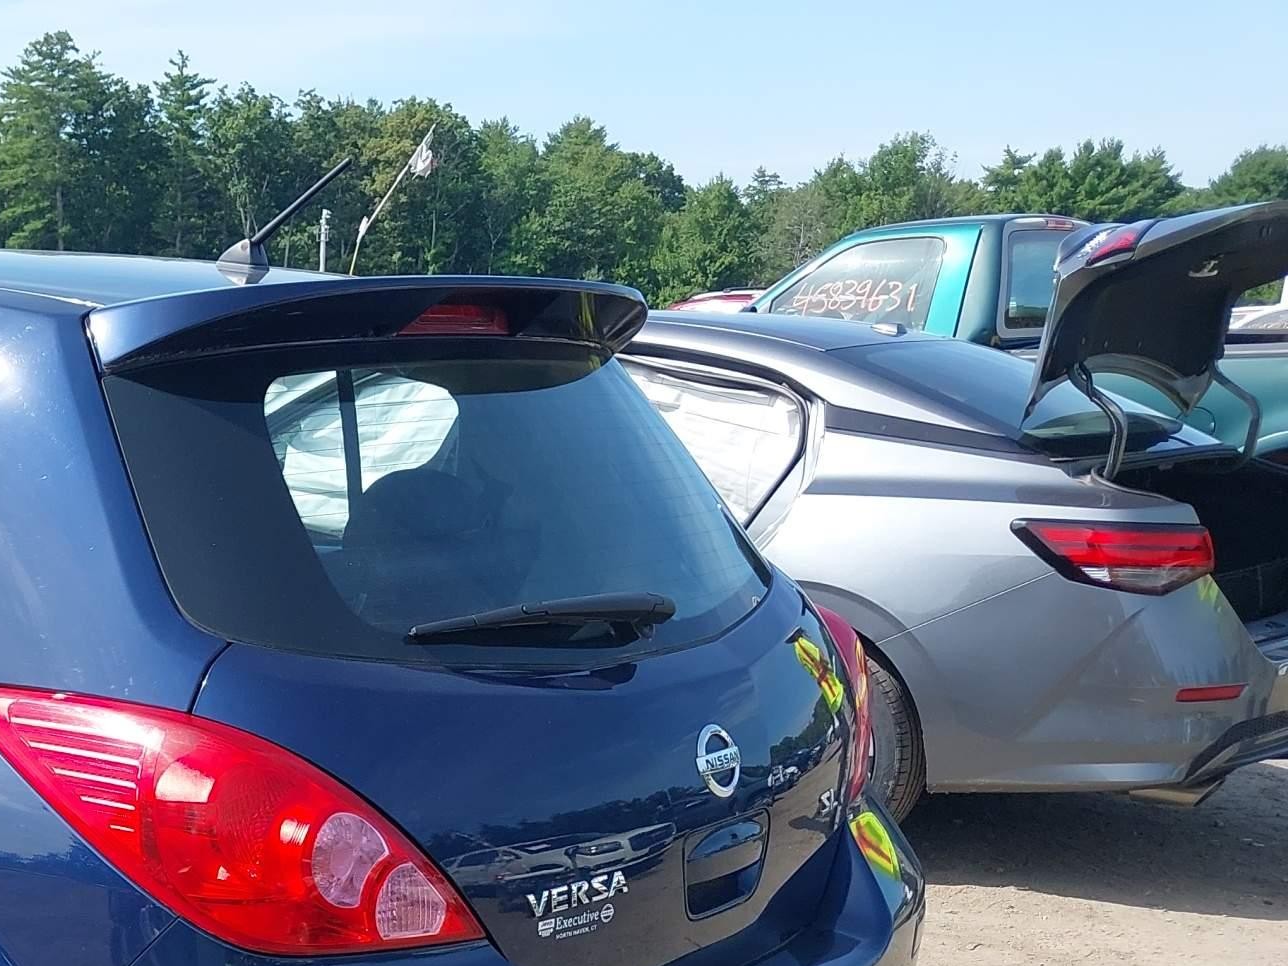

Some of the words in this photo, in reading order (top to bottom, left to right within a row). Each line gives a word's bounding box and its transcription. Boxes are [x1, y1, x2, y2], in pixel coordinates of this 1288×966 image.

[792, 279, 919, 317] 45839631
[705, 749, 740, 770] NISSAN
[820, 788, 838, 813] SL
[525, 870, 629, 918] VERSA
[555, 909, 600, 931] Executive
